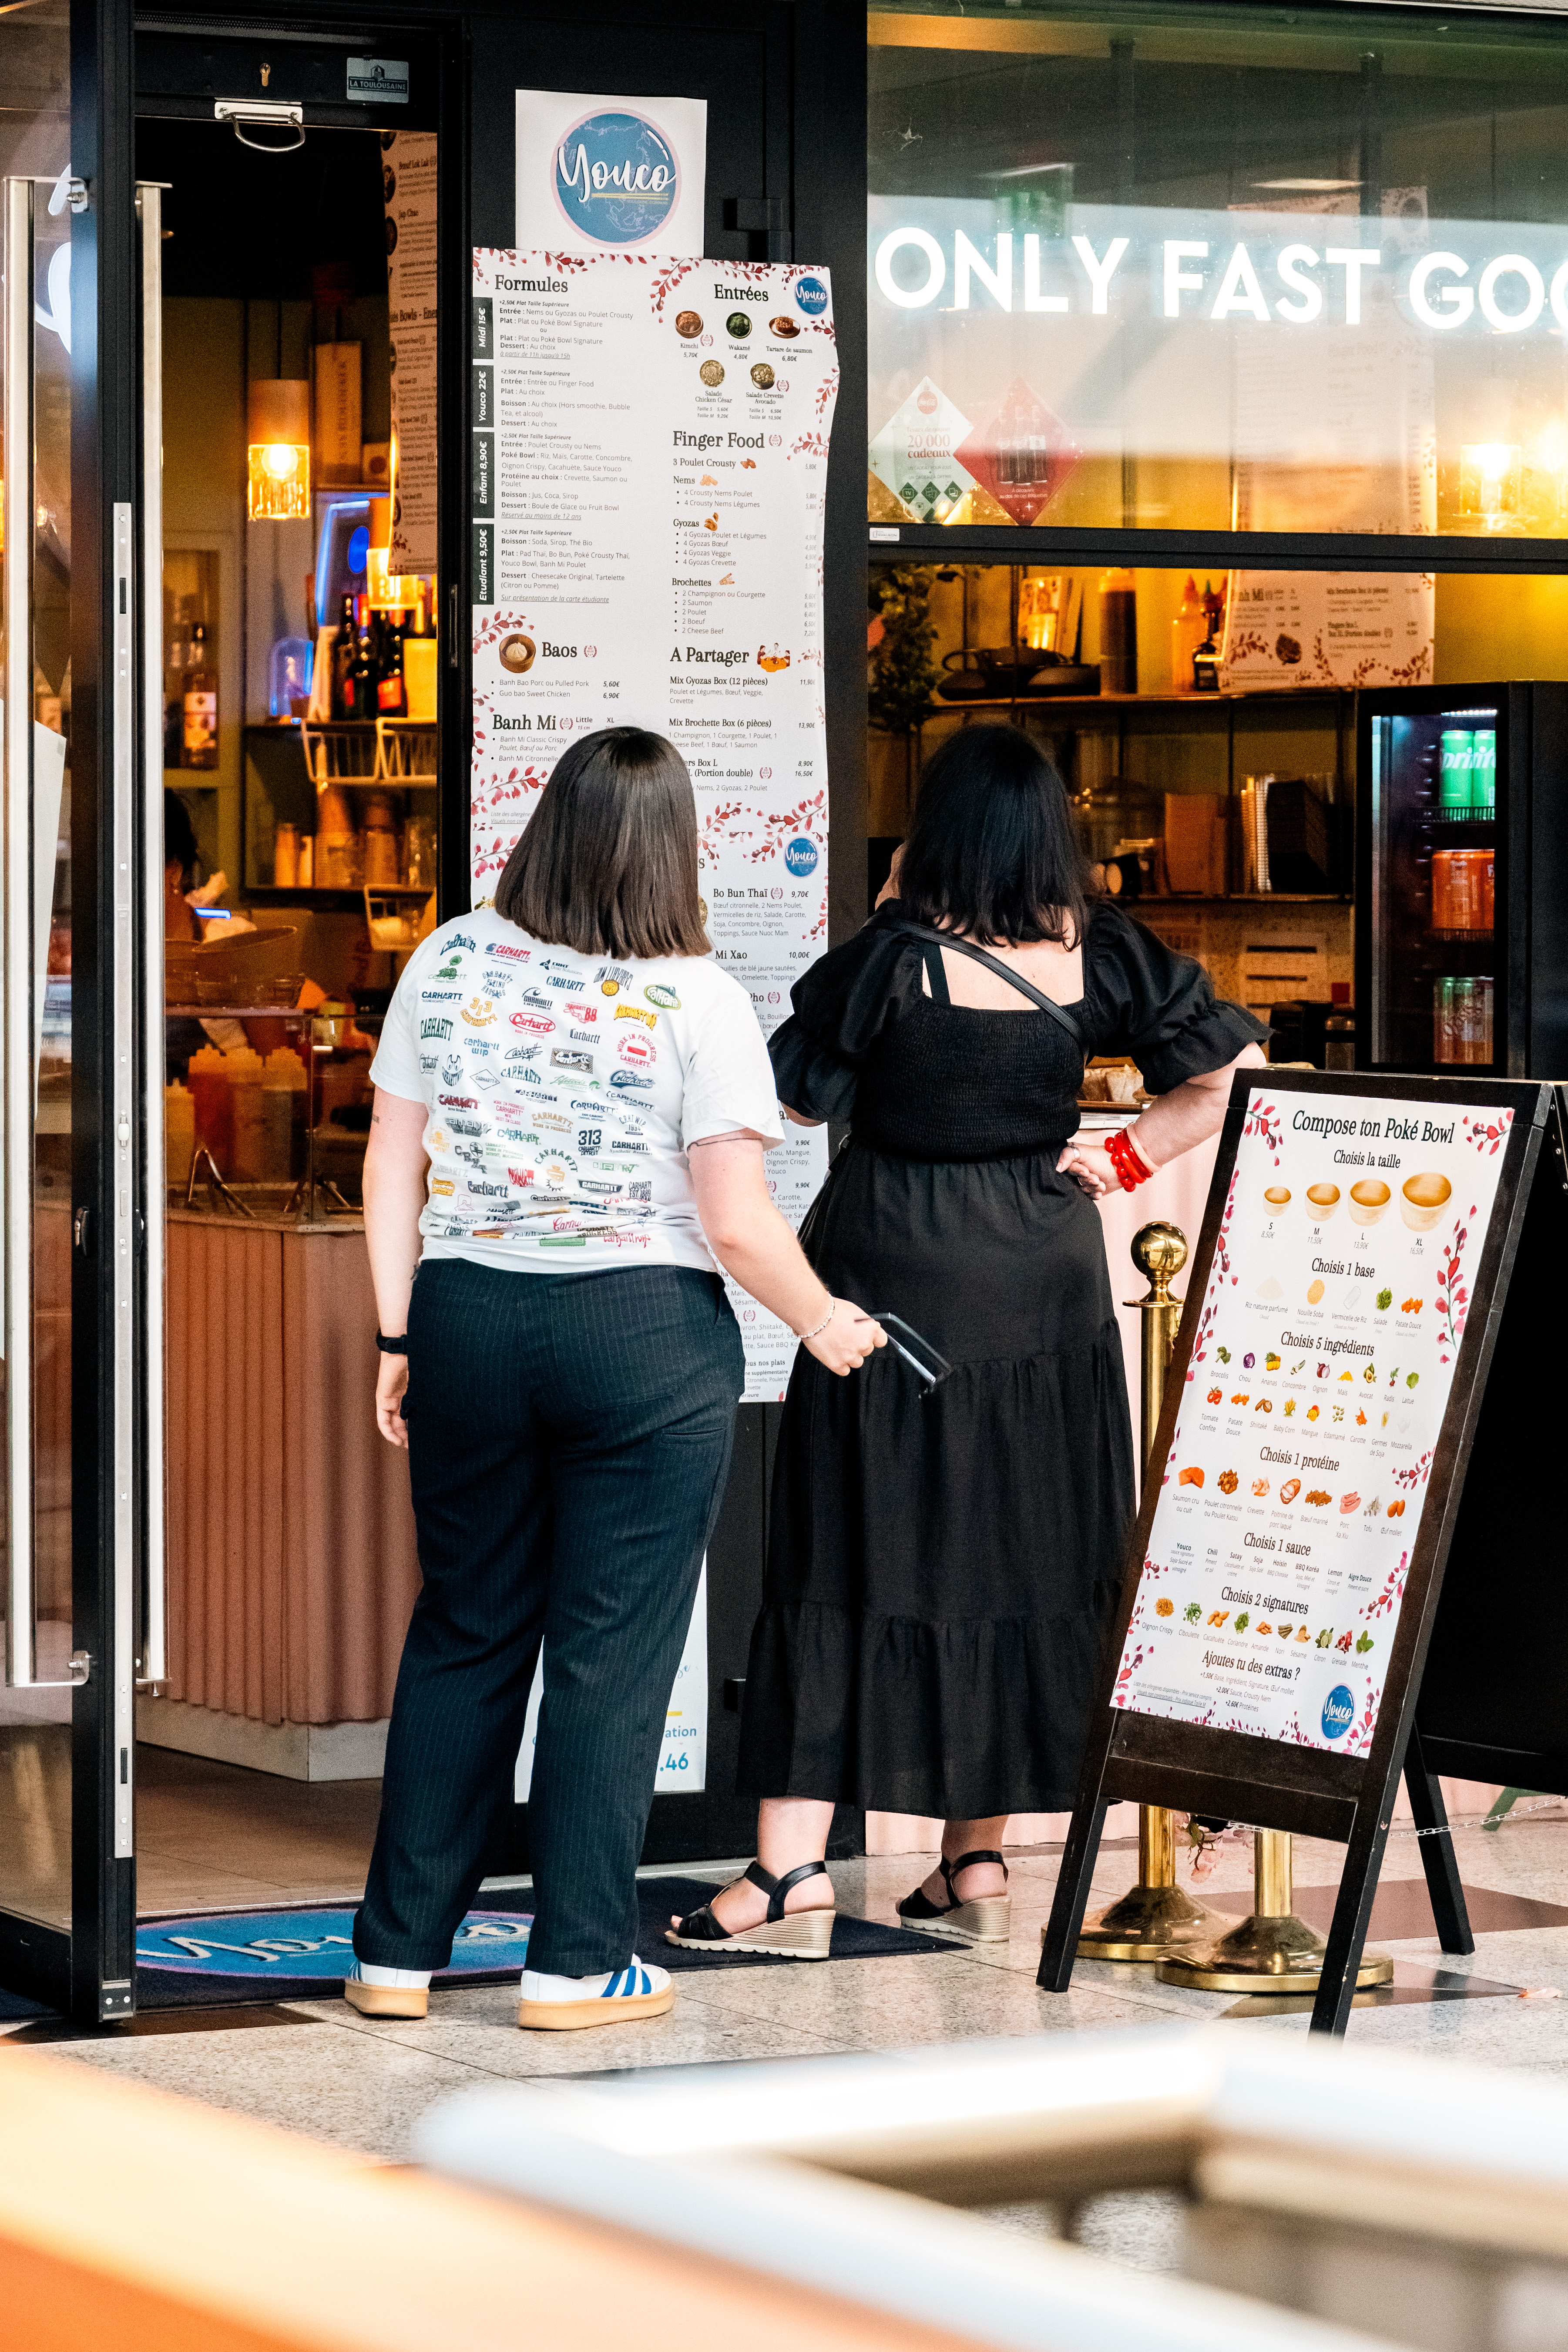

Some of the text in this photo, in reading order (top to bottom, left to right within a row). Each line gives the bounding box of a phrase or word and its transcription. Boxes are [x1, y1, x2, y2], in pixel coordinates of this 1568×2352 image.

[360, 81, 406, 90] TOULOUSAINE
[557, 143, 677, 203] Youco
[495, 275, 568, 292] Formules
[874, 226, 1568, 333] ONLY FAST GO
[714, 284, 769, 302] Entrées
[796, 286, 827, 303] Youco
[554, 309, 577, 318] Gyozas
[609, 311, 634, 320] Crousty
[478, 326, 486, 347] Midi
[673, 430, 765, 451] Finger Food
[908, 434, 950, 448] 20 000
[907, 447, 951, 458] cadeaux
[680, 458, 704, 466] Poulet
[706, 458, 736, 469] Crousty
[479, 440, 488, 504] Enfant 8,90€
[673, 476, 695, 484] Nems
[673, 518, 699, 529] Gyozas
[479, 528, 488, 601] Etudiant 9,50€
[672, 578, 712, 586] Brochettes
[542, 642, 578, 658] Baos
[670, 647, 749, 668] A Partager
[670, 676, 684, 684] Mix
[685, 676, 712, 686] Gyozas
[729, 677, 740, 685] (12
[742, 677, 768, 687] pièces)
[492, 714, 557, 730] Banh Mi
[685, 718, 720, 726] Brochette
[722, 719, 735, 727] Box
[737, 719, 745, 728] (6
[746, 719, 772, 729] pièces)
[695, 769, 753, 778] (Portion double)
[786, 847, 818, 864] Youco
[713, 888, 768, 897] Bo Bun Thaï
[715, 950, 747, 959] Mi Xao
[1293, 1110, 1455, 1143] Compose ton Poké Bowl
[1333, 1149, 1401, 1169] Choisis la taille
[1261, 1230, 1275, 1239] 8,50€
[1307, 1236, 1323, 1245] 11,50€
[1353, 1241, 1369, 1250] 13,90€
[1415, 1238, 1422, 1246] XL
[1312, 1257, 1375, 1278] Choisis 1 base
[1373, 1317, 1387, 1326] Salade
[1281, 1331, 1374, 1356] Choisis 5 ingrédients
[771, 1359, 786, 1368] plats
[1210, 1370, 1229, 1379] Brocolis
[1260, 1378, 1277, 1386] Ananas
[1282, 1381, 1306, 1391] Concombre
[1313, 1385, 1328, 1394] Oignon
[1260, 1446, 1340, 1471] Choisis 1 protéine
[1247, 1506, 1265, 1515] Crevette
[1177, 1542, 1192, 1551] Youco
[1244, 1532, 1311, 1556] Choisis 1 sauce
[1229, 1552, 1242, 1562] Satay
[1253, 1556, 1263, 1565] Soja
[1295, 1563, 1306, 1572] BBQ
[1327, 1569, 1343, 1577] Lemon
[1348, 1573, 1359, 1582] Aigre
[1221, 1586, 1309, 1615] Choisis 2 signatures
[1202, 1650, 1301, 1681] Ajoutes tu des extras ?
[1323, 1697, 1354, 1721] Youco
